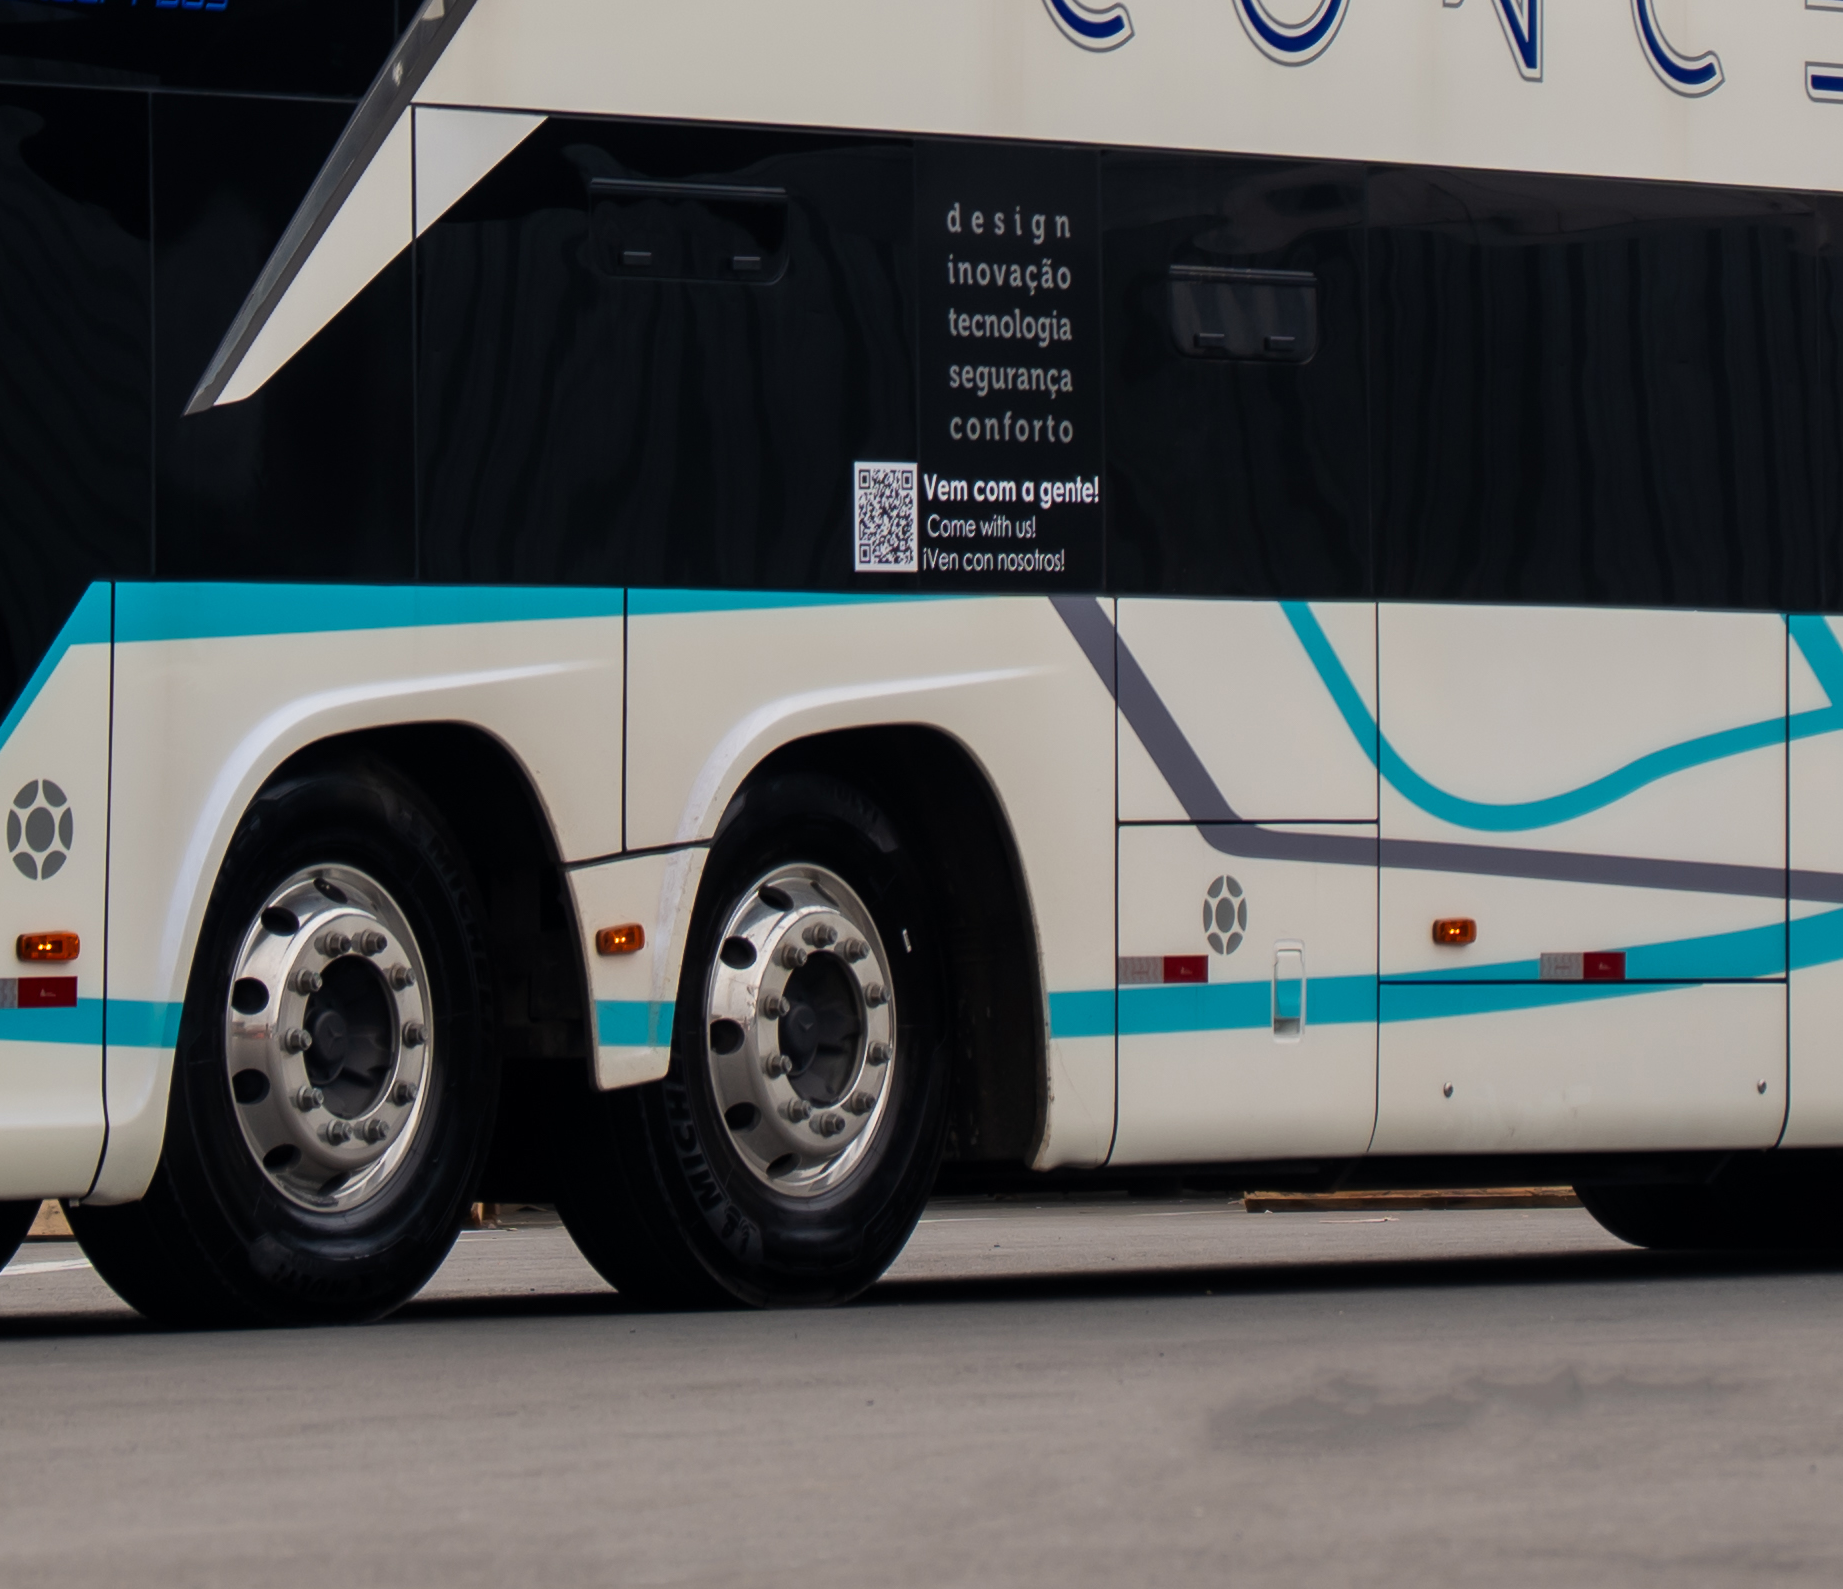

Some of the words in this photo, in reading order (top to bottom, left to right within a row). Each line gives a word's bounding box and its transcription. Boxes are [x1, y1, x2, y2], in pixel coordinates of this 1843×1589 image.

[947, 202, 1071, 245] design
[948, 253, 1072, 296] inovação
[948, 308, 1072, 348] tecnologia
[949, 364, 1073, 400] segurança
[950, 410, 1074, 444] conforto
[923, 473, 968, 502] Vem
[973, 480, 1017, 502] com
[1021, 480, 1035, 503] a
[1040, 475, 1099, 509] gente!
[927, 513, 977, 538] Come
[979, 514, 1012, 538] with
[1015, 515, 1036, 539] us!
[962, 552, 994, 571] con
[997, 548, 1065, 572] nosotros!
